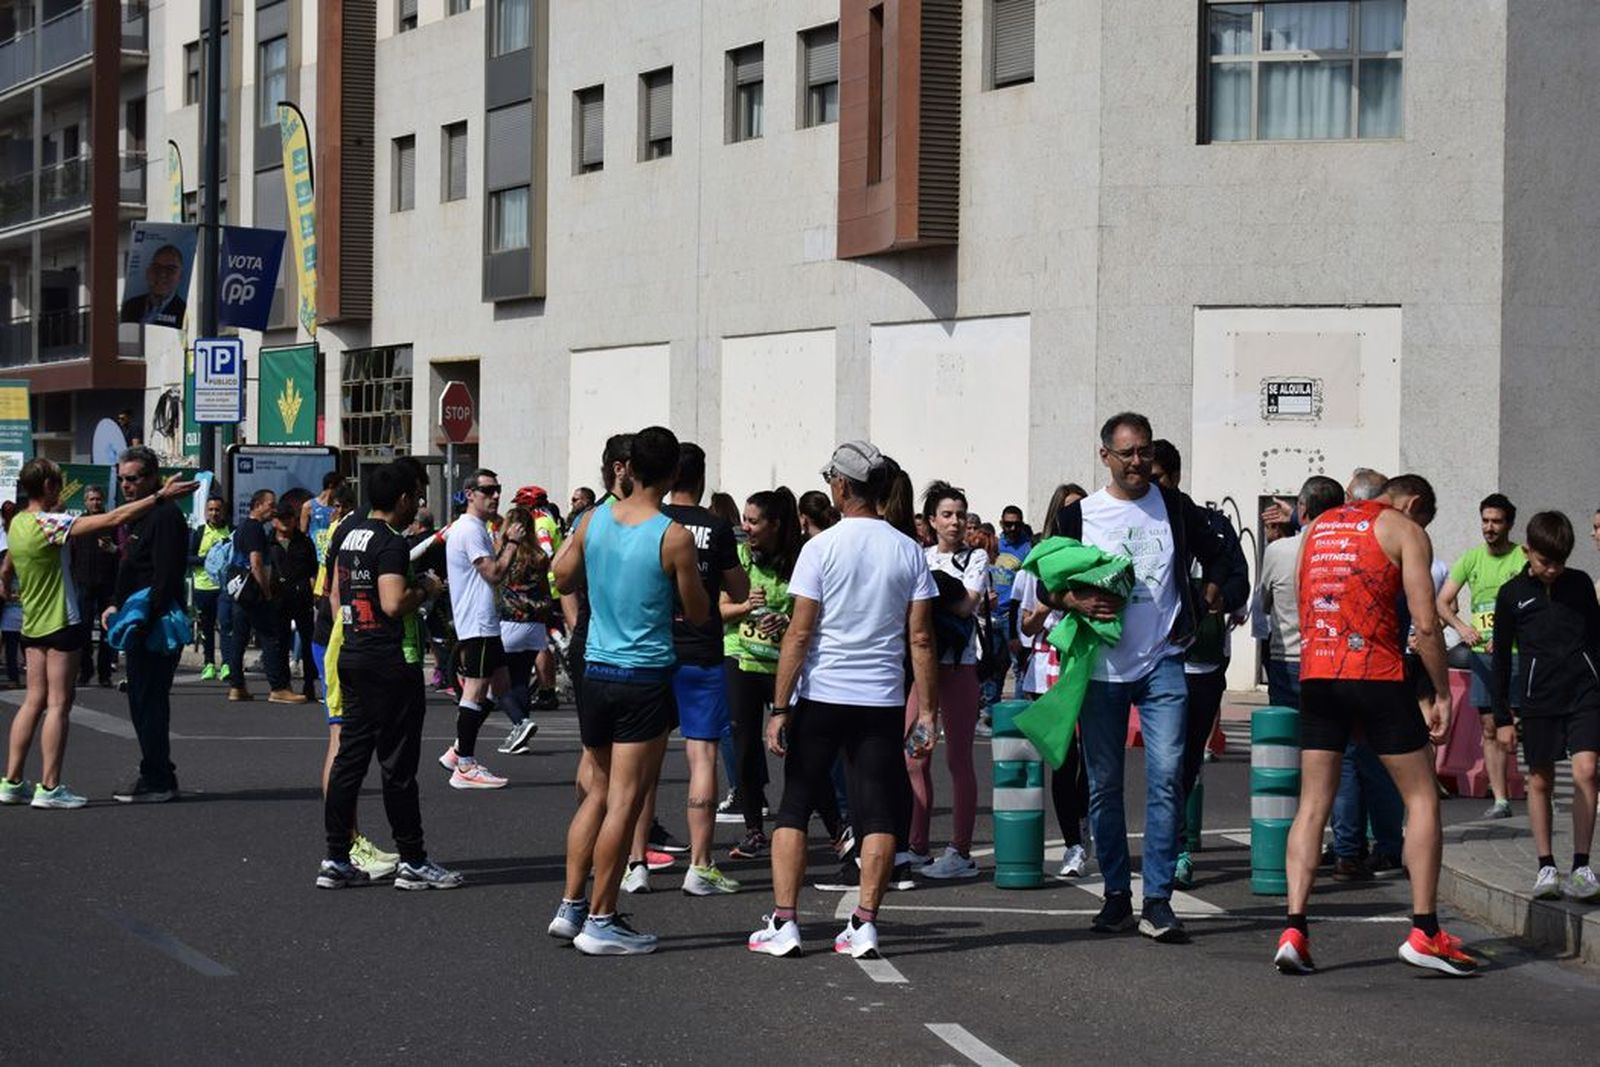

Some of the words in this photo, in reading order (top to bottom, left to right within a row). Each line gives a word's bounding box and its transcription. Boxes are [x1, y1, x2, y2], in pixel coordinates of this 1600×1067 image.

[228, 255, 263, 270] VOTA
[215, 348, 231, 372] P
[1268, 384, 1278, 395] SE
[1279, 384, 1312, 395] ALQUILA
[445, 406, 470, 420] STOP
